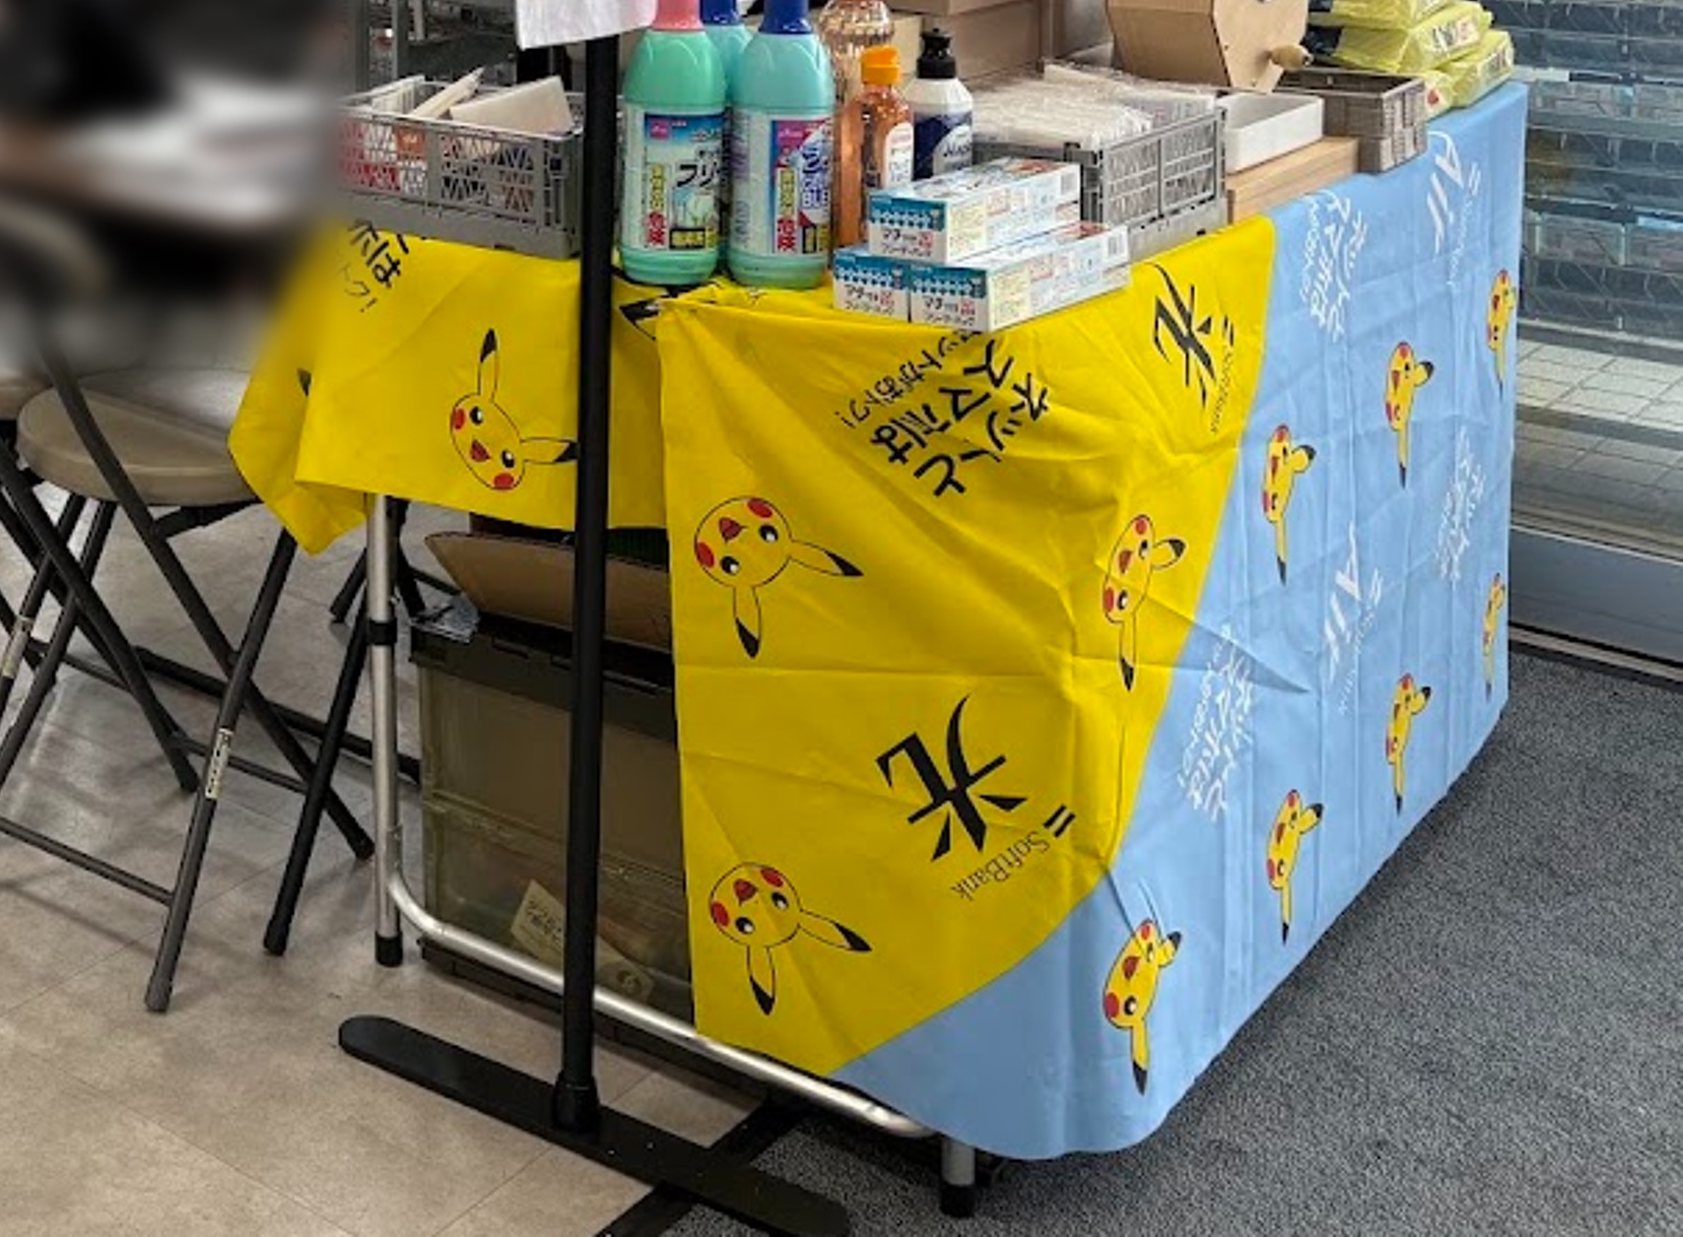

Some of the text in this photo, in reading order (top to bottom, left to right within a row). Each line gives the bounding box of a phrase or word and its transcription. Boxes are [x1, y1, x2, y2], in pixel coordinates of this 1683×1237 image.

[870, 339, 1014, 464] スマホは
[913, 372, 1048, 497] ネットと
[874, 692, 1031, 864] 光
[949, 829, 1051, 902] SoftBank
